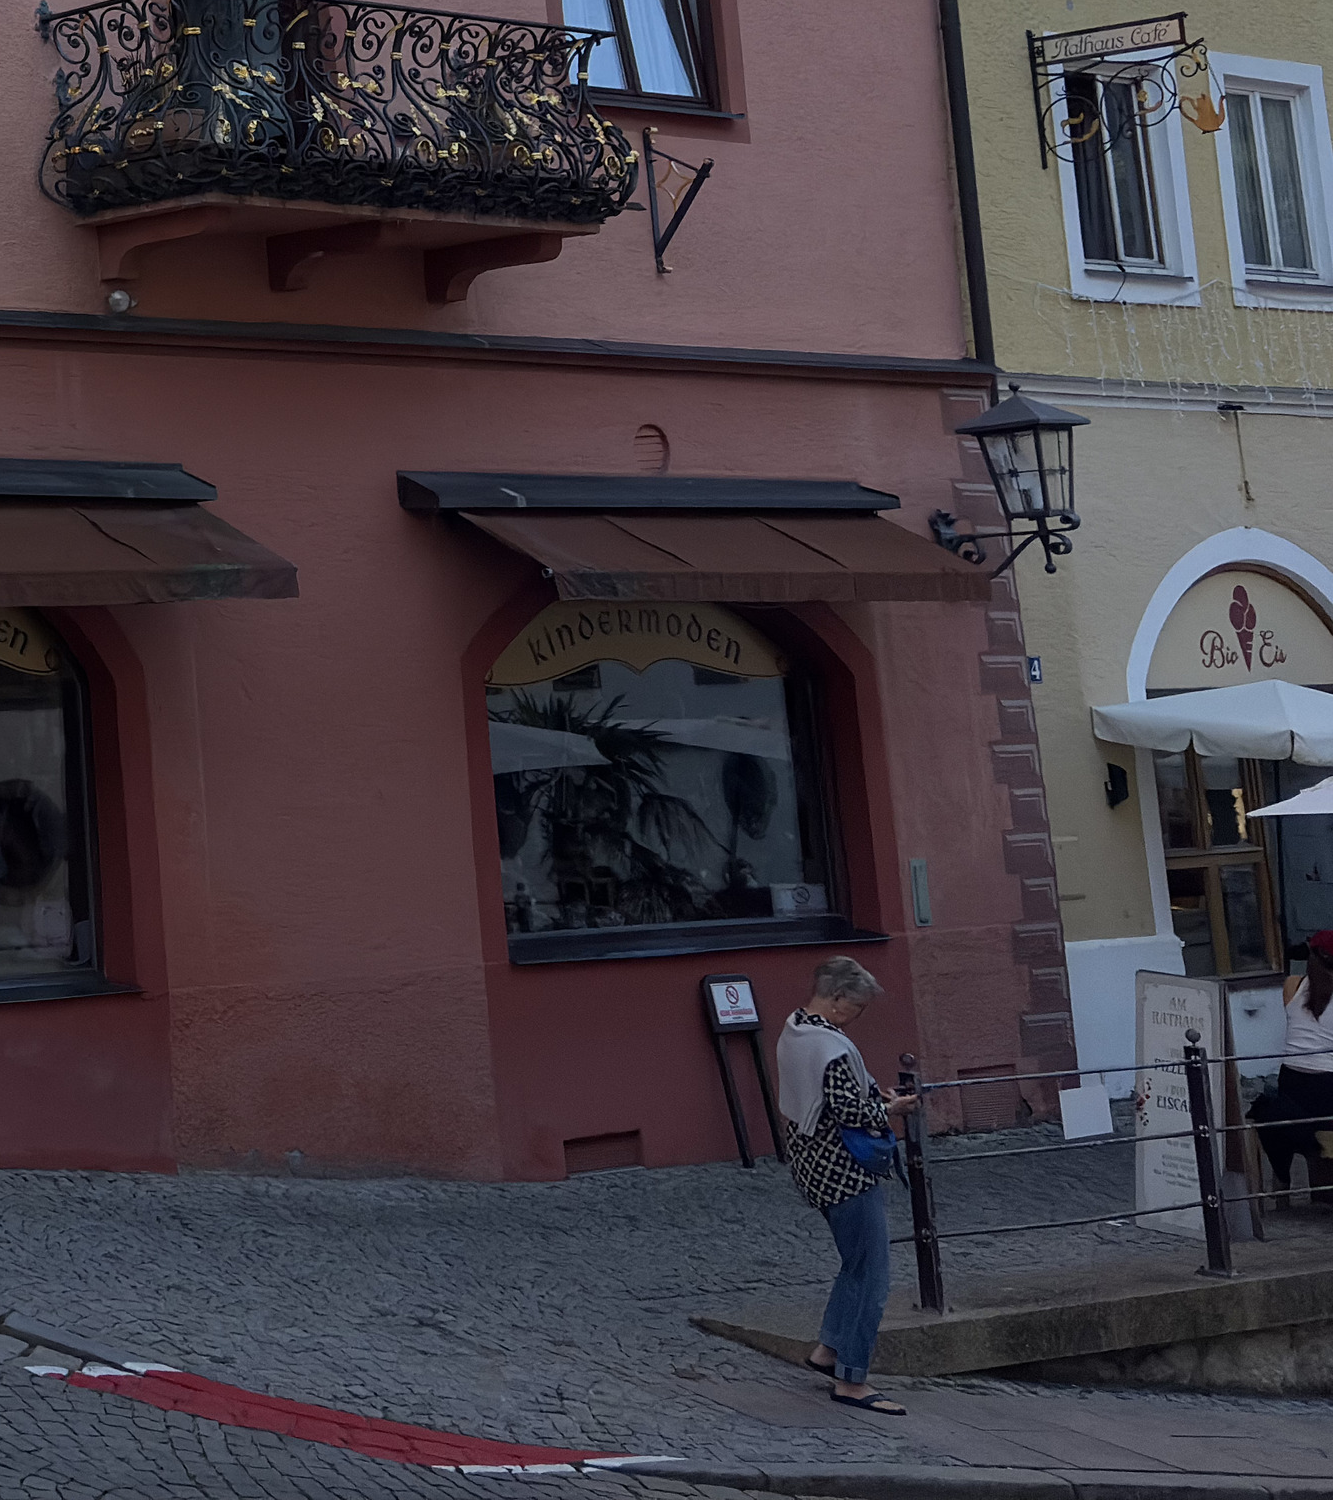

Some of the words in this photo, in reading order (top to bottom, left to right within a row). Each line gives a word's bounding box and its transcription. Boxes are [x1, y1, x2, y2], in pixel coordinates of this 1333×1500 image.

[1051, 35, 1124, 59] Rathaus
[1130, 22, 1171, 46] Café
[1200, 630, 1239, 668] Bio
[1259, 630, 1287, 667] Eis
[1031, 660, 1041, 680] 4
[1157, 1095, 1190, 1113] EISCA
